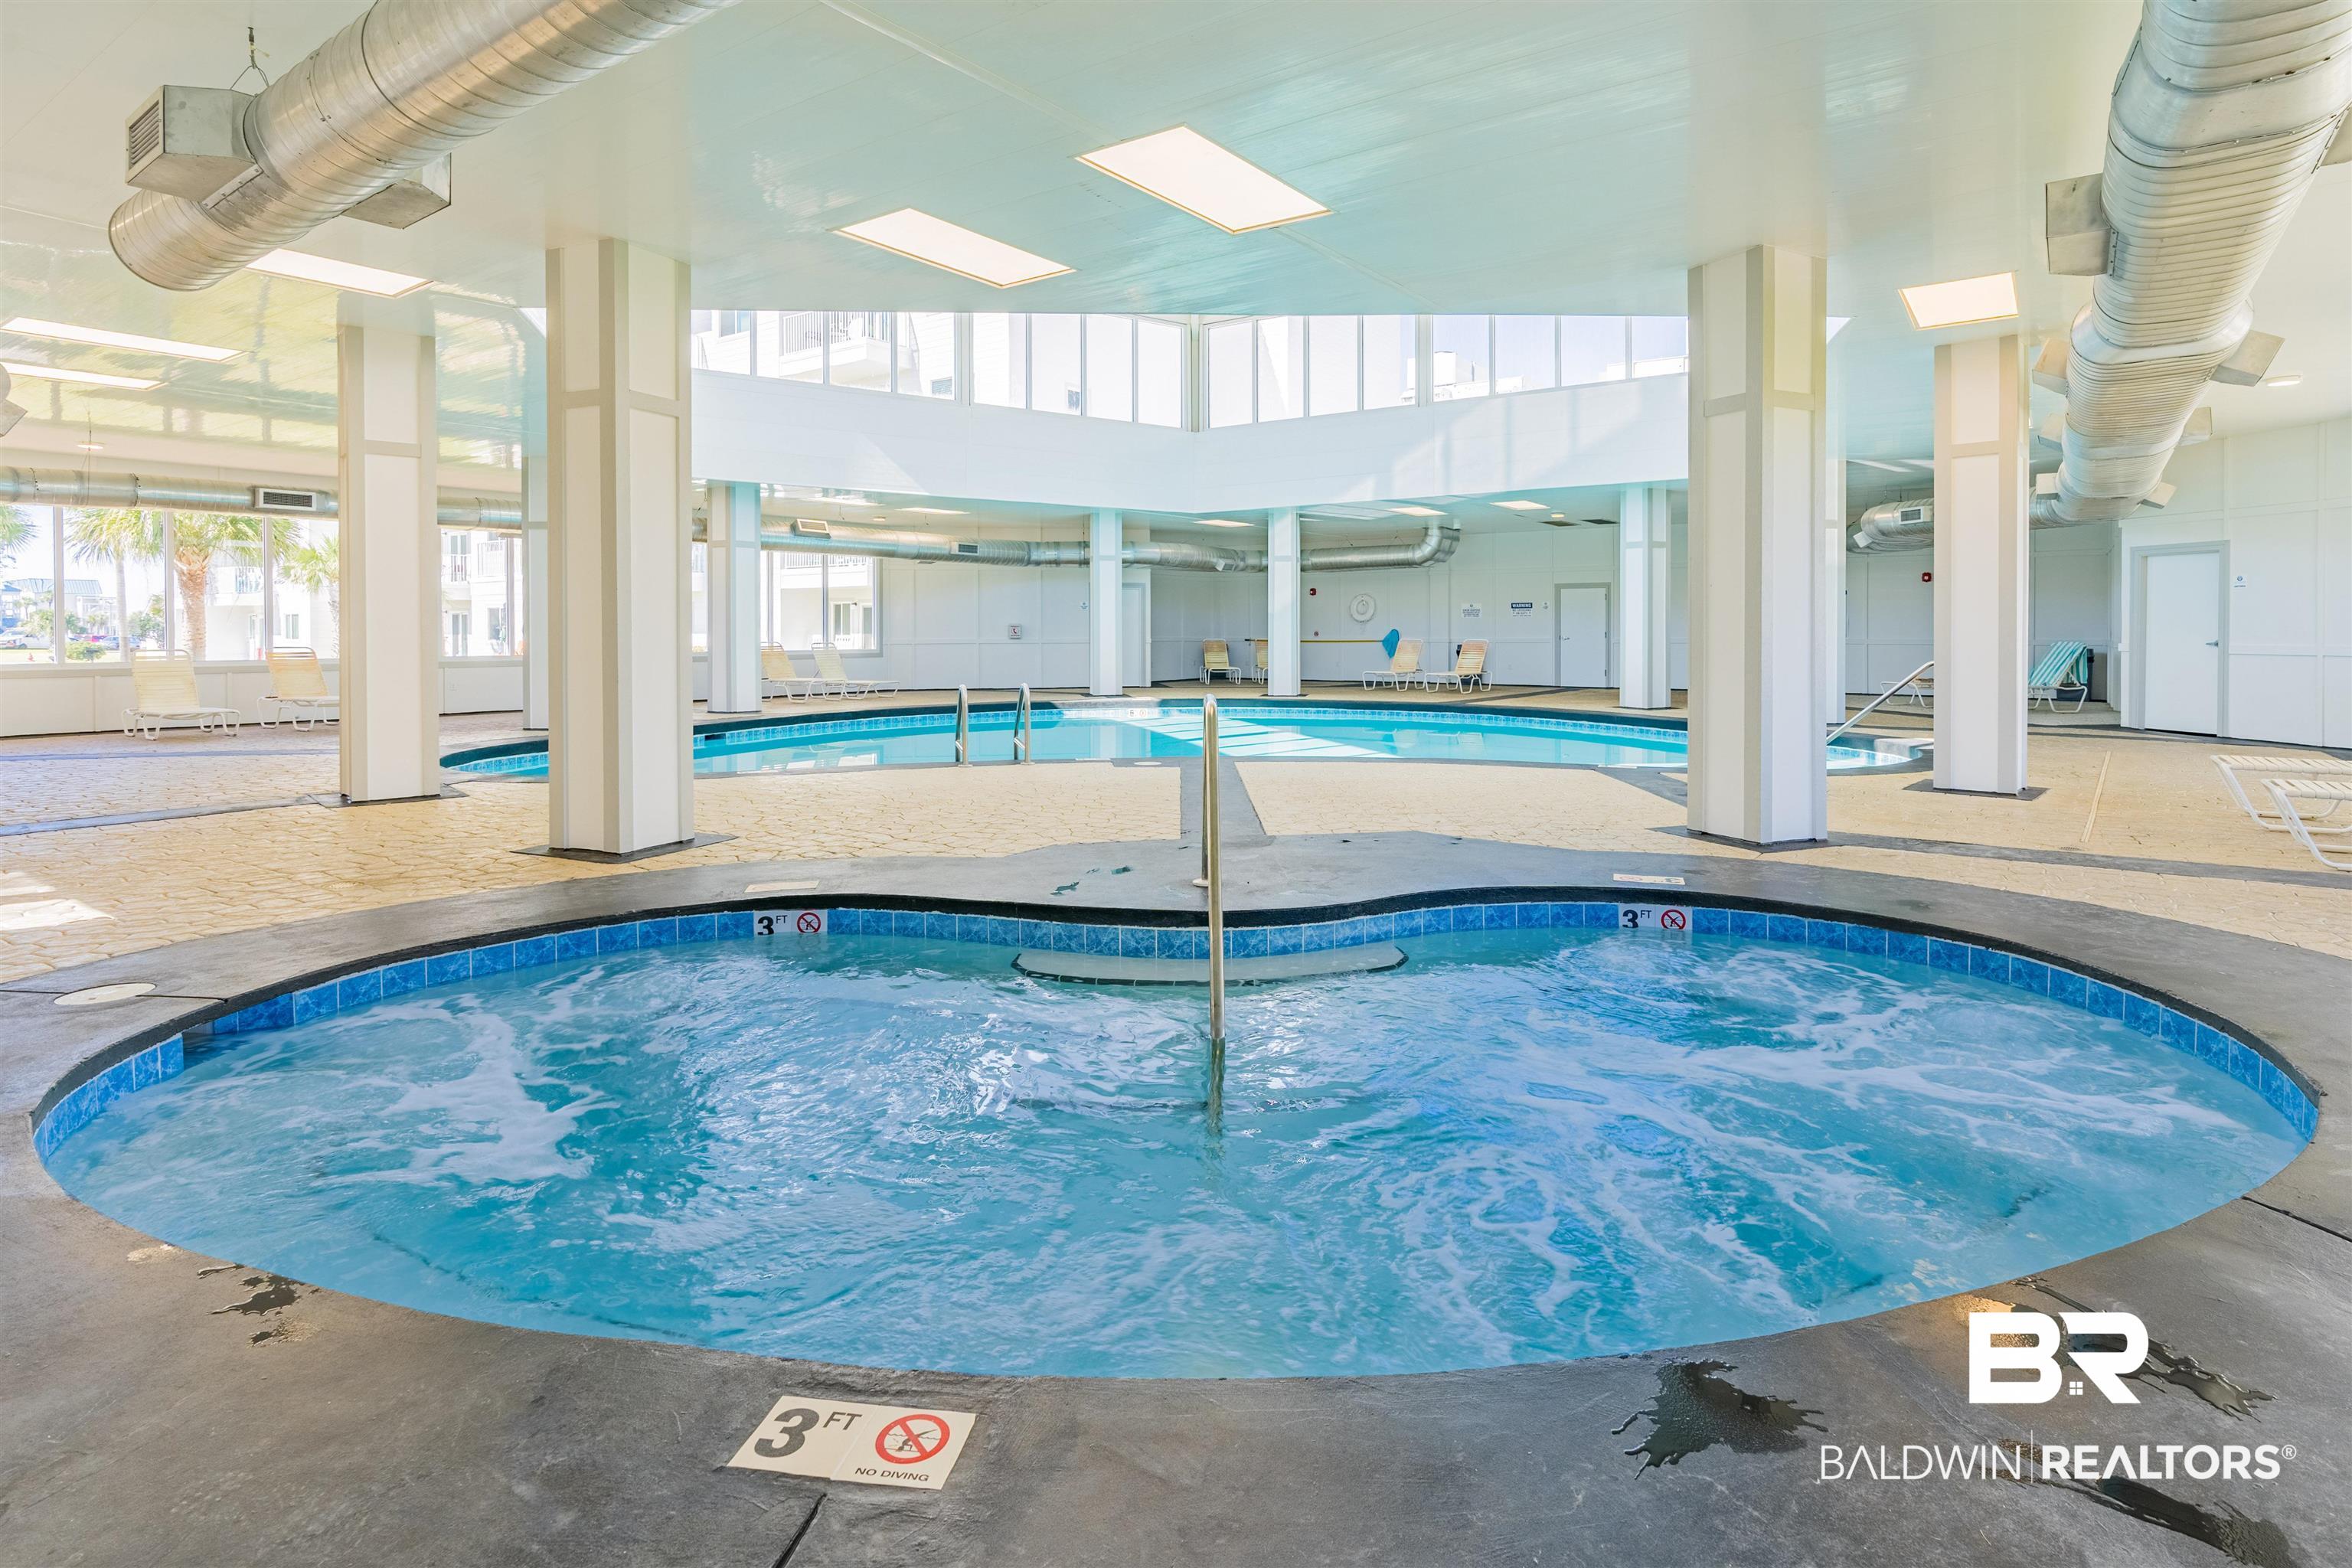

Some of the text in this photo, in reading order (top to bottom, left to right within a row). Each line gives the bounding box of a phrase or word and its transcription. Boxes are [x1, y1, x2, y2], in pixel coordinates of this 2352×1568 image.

[757, 915, 788, 936] 3 FT
[1622, 909, 1652, 929] 3 FT
[754, 1408, 863, 1459] 3 FT
[854, 1467, 930, 1483] NO DIVING
